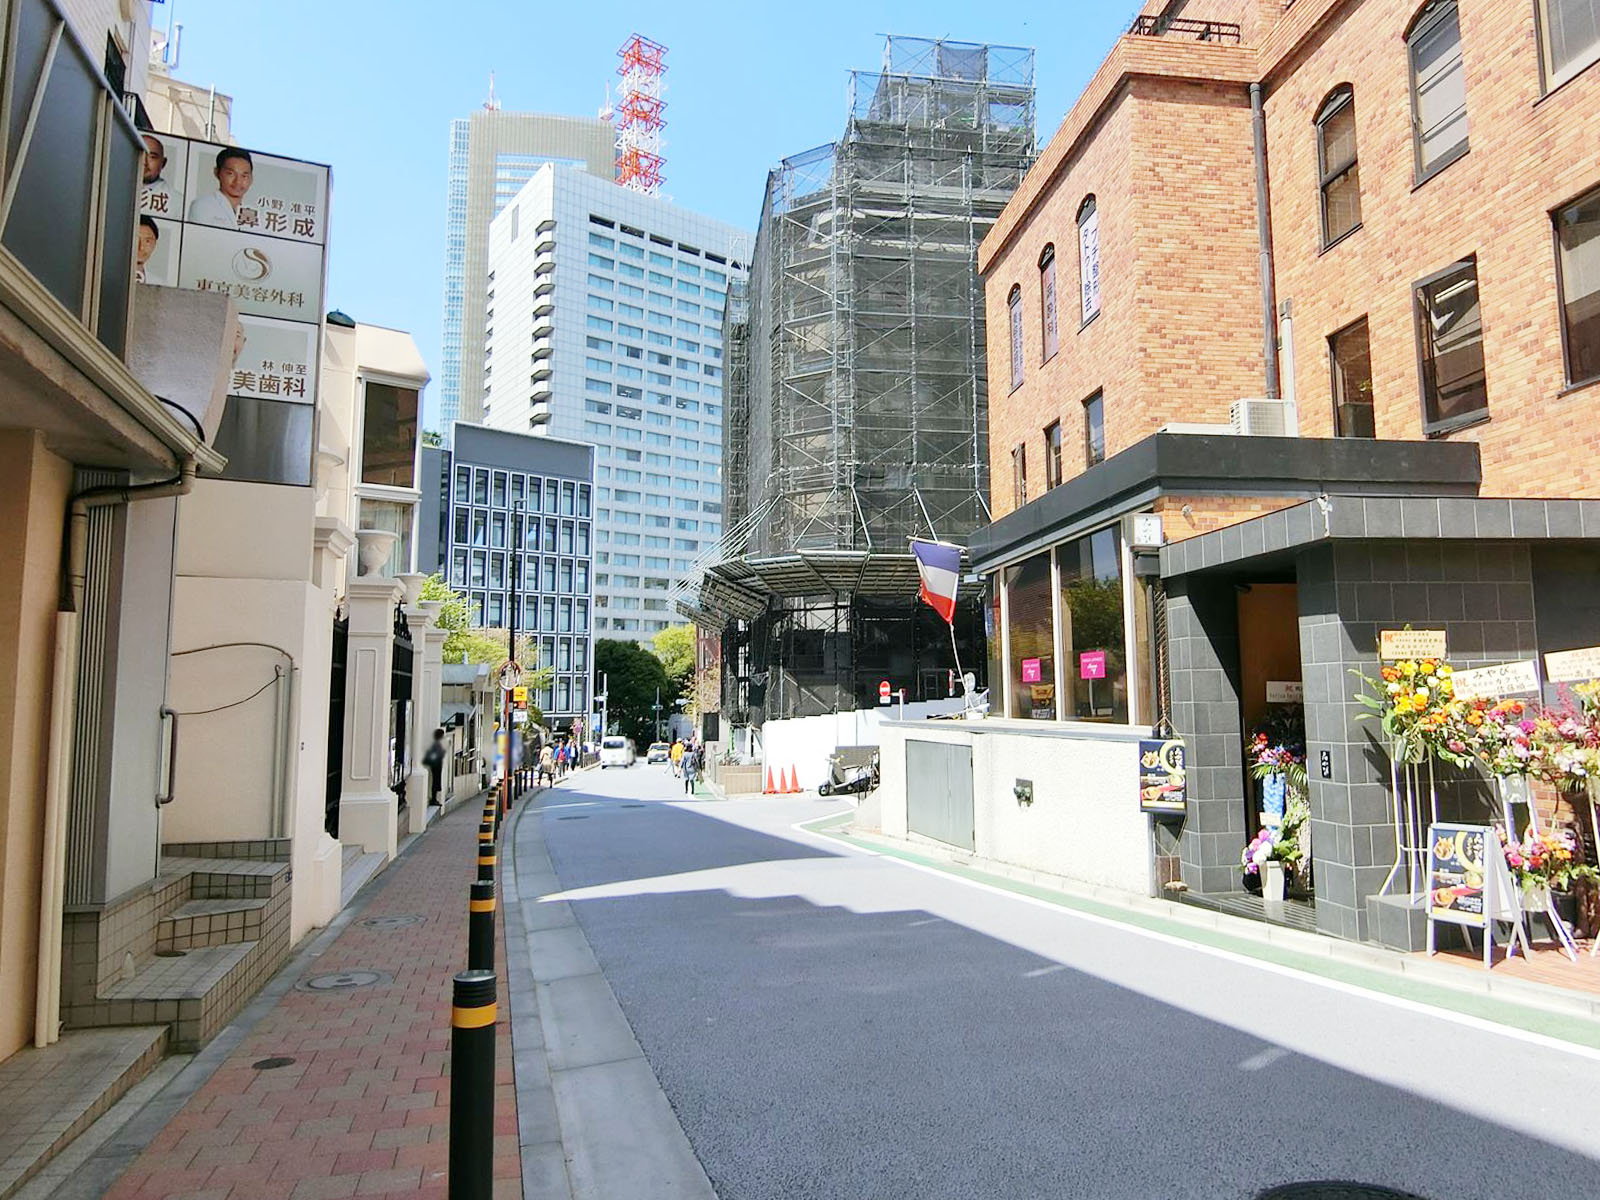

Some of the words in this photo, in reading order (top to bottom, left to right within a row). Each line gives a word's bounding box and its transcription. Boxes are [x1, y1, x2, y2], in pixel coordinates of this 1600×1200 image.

[257, 196, 284, 210] 小野
[236, 207, 315, 237] 鼻形成
[195, 277, 305, 309] 東京美容外科
[262, 360, 274, 371] 林
[228, 371, 306, 398] 美歯科
[1473, 665, 1510, 680] みやび
